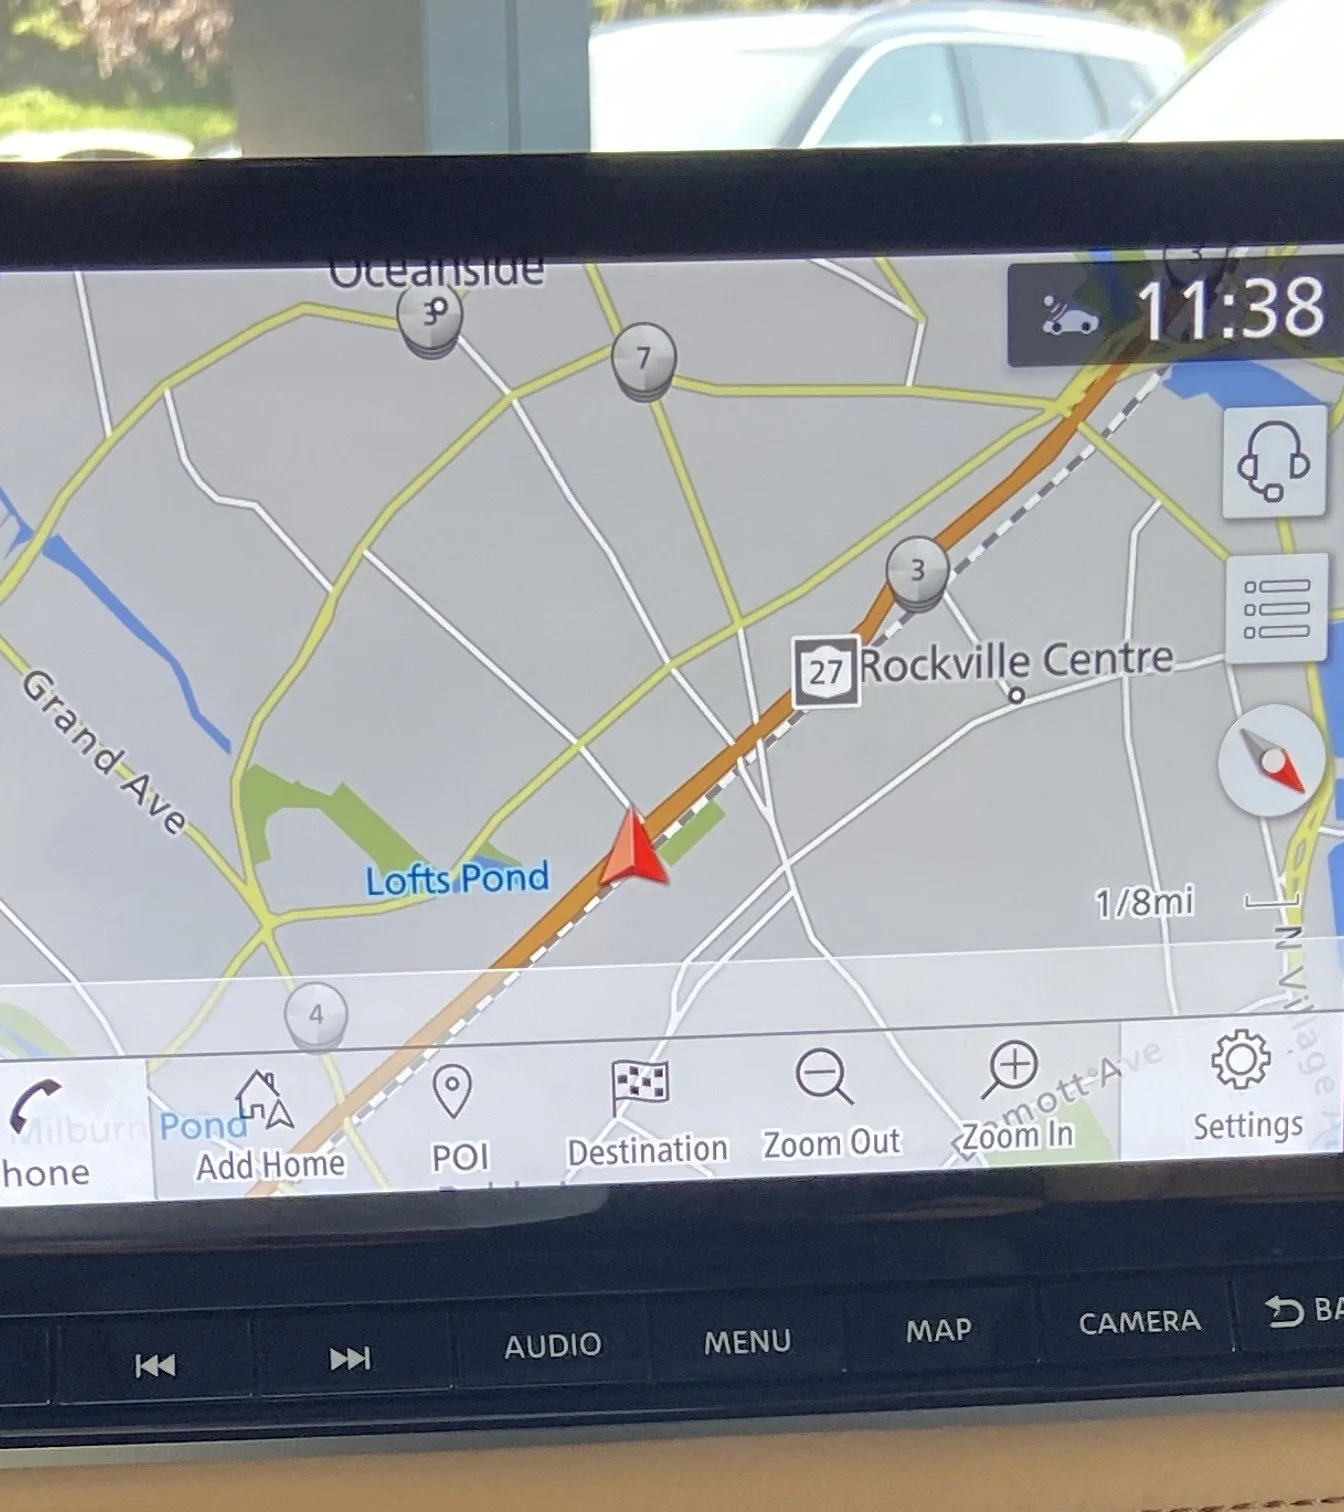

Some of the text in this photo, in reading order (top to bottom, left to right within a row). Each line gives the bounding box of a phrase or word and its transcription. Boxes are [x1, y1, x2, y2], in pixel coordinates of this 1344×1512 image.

[329, 258, 545, 288] Oceanside
[1138, 276, 1324, 341] 11:38
[637, 346, 652, 371] 7
[909, 558, 925, 582] 3
[809, 658, 844, 686] 27
[860, 639, 1174, 685] Rockville Centre
[22, 669, 187, 836] Grand Ave
[366, 860, 550, 897] Lofts Pond
[1096, 885, 1196, 919] 1/8mi
[1275, 926, 1302, 950] N
[308, 1003, 324, 1027] 4
[1278, 965, 1335, 1096] Village
[1101, 1043, 1164, 1088] Ave
[161, 1111, 248, 1141] Pond
[962, 1119, 1073, 1150] Zoom In
[1194, 1111, 1303, 1143] Settings
[433, 1143, 488, 1172] POI
[569, 1135, 728, 1167] Destination
[764, 1127, 901, 1160] Zoom Out
[196, 1150, 345, 1182] Add Home
[906, 1318, 973, 1344] MAP
[1078, 1308, 1202, 1337] CAMERA
[504, 1332, 603, 1360] AUDIO
[703, 1329, 792, 1356] MENU
